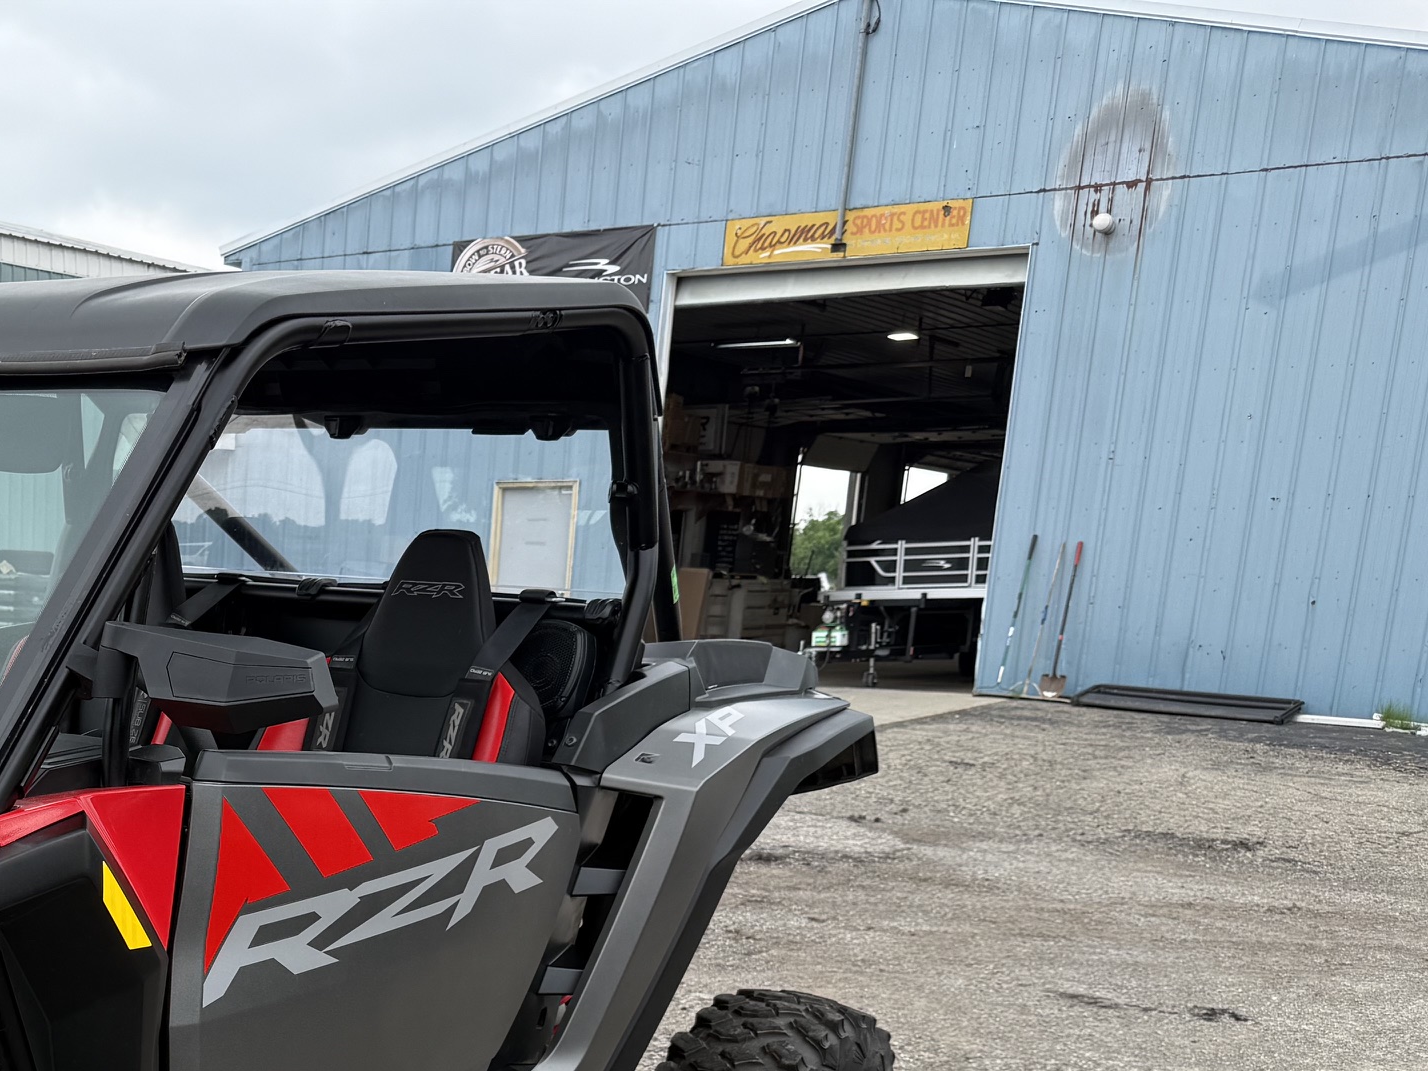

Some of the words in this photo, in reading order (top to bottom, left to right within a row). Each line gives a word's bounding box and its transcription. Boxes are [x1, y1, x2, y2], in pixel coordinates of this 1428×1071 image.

[462, 252, 479, 273] BOW
[487, 244, 513, 259] STERN
[731, 219, 849, 259] Chapman
[850, 211, 906, 236] SPORTS
[910, 206, 967, 231] CENTER
[391, 580, 465, 599] RZR
[246, 673, 307, 685] POLARIS
[439, 702, 465, 759] RZR
[673, 705, 746, 769] XP
[203, 816, 559, 1008] RZR
